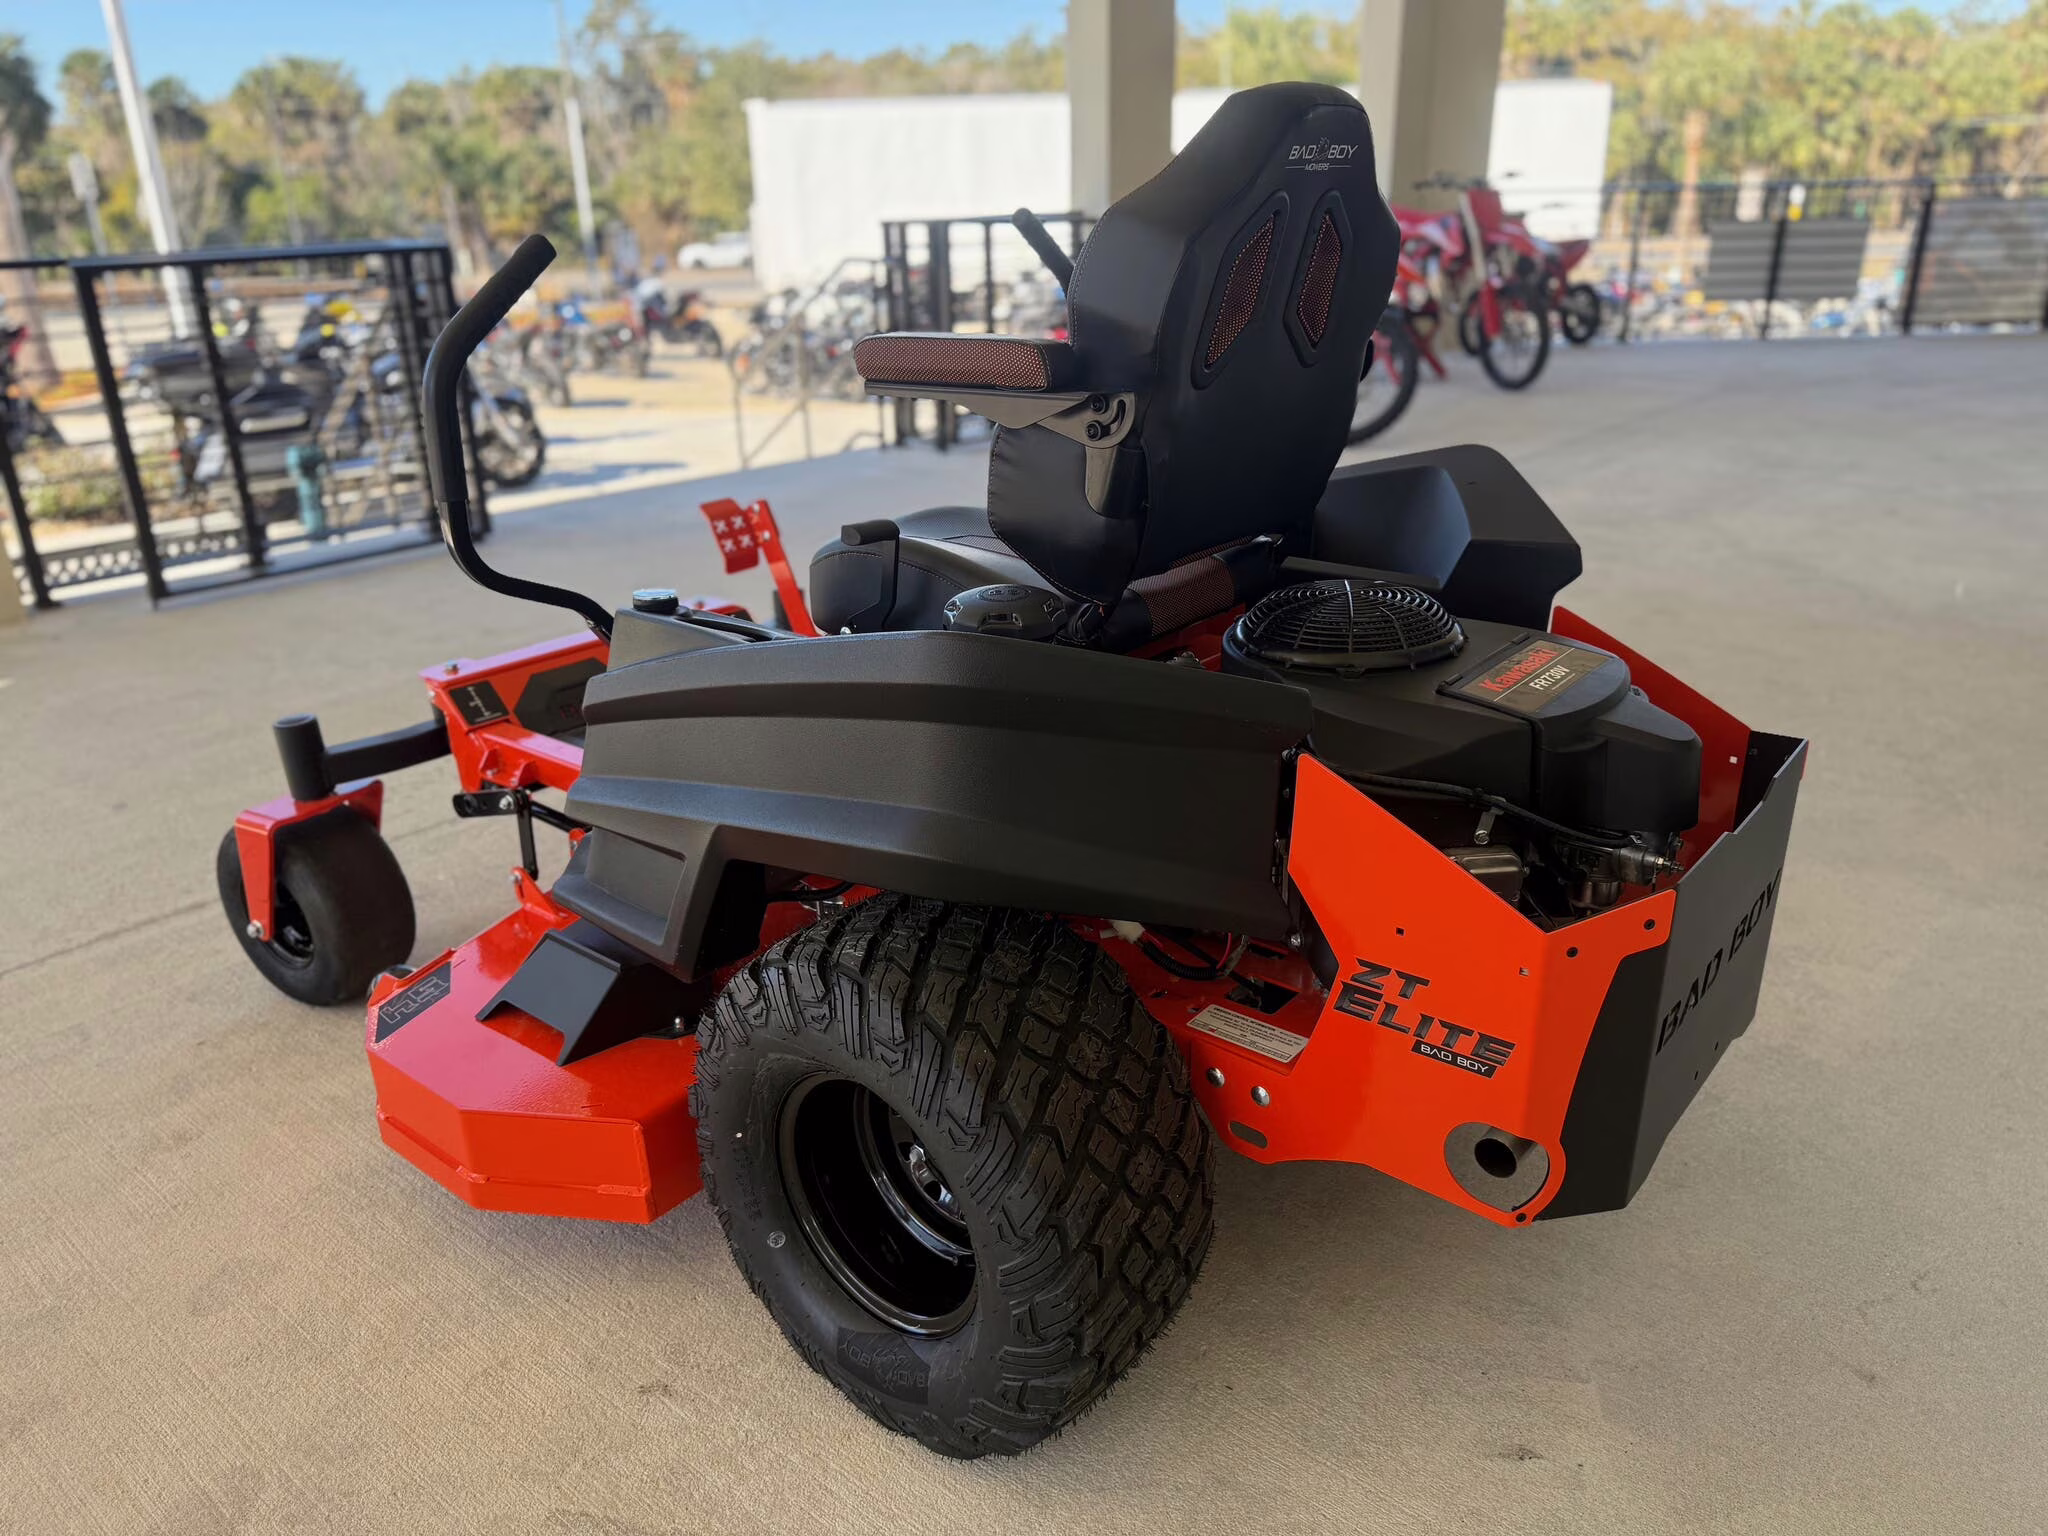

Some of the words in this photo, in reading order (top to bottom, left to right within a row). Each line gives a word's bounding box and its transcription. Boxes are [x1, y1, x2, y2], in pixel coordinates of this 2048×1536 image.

[1288, 145, 1317, 159] BAD
[1327, 144, 1359, 159] BOY
[1479, 648, 1560, 693] Kawasaki
[1528, 664, 1571, 691] FR730V
[1350, 957, 1430, 1000] ZT
[1656, 948, 1724, 1056] BAD
[1728, 867, 1782, 962] BOY
[1333, 980, 1517, 1067] ELITE
[1420, 1044, 1452, 1062] BAD
[1456, 1056, 1489, 1073] BOY
